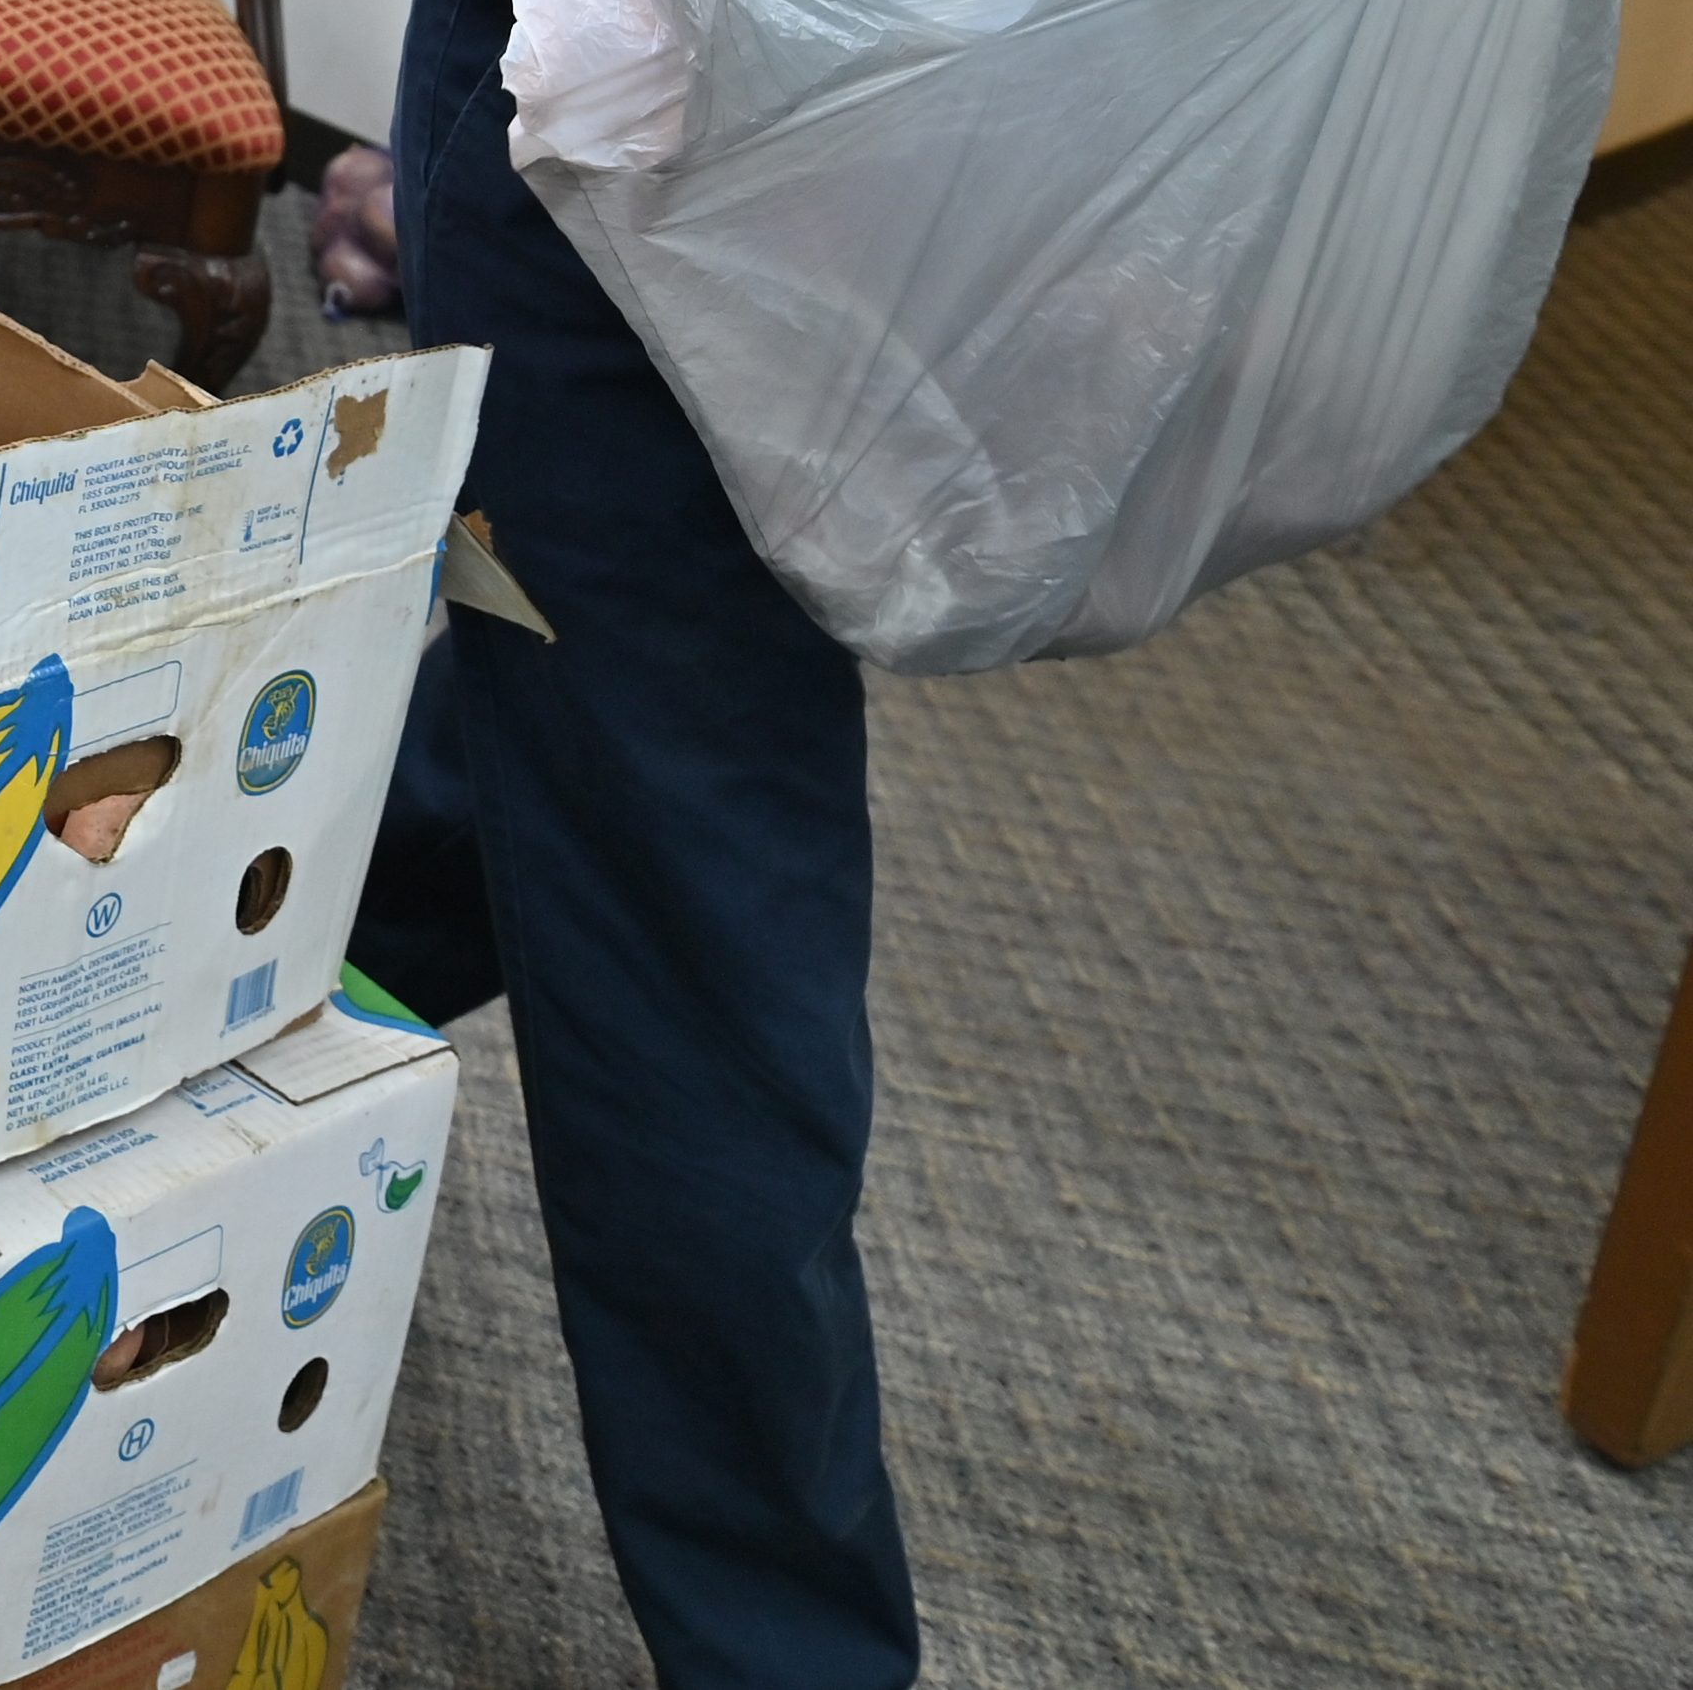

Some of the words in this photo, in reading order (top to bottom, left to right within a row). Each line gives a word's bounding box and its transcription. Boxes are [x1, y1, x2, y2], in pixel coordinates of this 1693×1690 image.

[84, 467, 140, 488] TRADEMARKS
[141, 464, 154, 476] OF
[198, 449, 229, 468] BRANDS
[85, 458, 126, 476] CHIQUITA
[127, 453, 145, 466] AND
[9, 468, 80, 506] Chiquita
[81, 487, 104, 501] 1855
[105, 481, 136, 497] GRIFFIN
[163, 471, 190, 483] FORT
[78, 503, 89, 514] FL
[90, 492, 141, 512] 33004-2275
[72, 534, 120, 555] FOLLOWING
[121, 525, 159, 545] PATENTS
[74, 529, 92, 541] THIS
[93, 525, 111, 537] BOX
[113, 522, 122, 533] IS
[122, 510, 174, 532] PROTECTED
[69, 570, 81, 581] EU
[81, 564, 116, 578] PATENT
[71, 556, 81, 568] US
[82, 550, 116, 565] PATENT
[67, 593, 93, 608] THINK
[94, 585, 123, 602] GREEN!
[124, 581, 141, 593] USE
[141, 577, 162, 590] THIS
[163, 572, 179, 585] BOX
[68, 608, 94, 622] AGAIN
[95, 603, 113, 616] AND
[114, 596, 141, 611] AGAIN
[141, 592, 161, 604] AND
[240, 727, 312, 775] Chiquita
[91, 899, 117, 931] W
[17, 987, 58, 1006] CHIQUITA
[84, 965, 110, 982] NORTH
[112, 951, 145, 970] AMERICA
[18, 979, 49, 995] NORTH
[14, 1017, 36, 1030] FORT
[16, 1004, 38, 1019] 1855
[10, 1051, 50, 1068] VARIETY:
[94, 1021, 115, 1036] TYPE
[11, 1037, 54, 1055] PRODUCT:
[55, 1019, 92, 1042] BANANAS
[8, 1073, 51, 1094] COUNTRY
[53, 1069, 63, 1079] OF
[65, 1056, 94, 1073] ORIGIN:
[95, 1033, 146, 1059] GUATEMALA
[9, 1065, 40, 1081] CLASS:
[41, 1053, 69, 1071] EXTRA
[6, 1108, 24, 1119] NET
[40, 1100, 76, 1121] CHIQUITA
[283, 1259, 350, 1312] Chiquita
[125, 1426, 149, 1455] H
